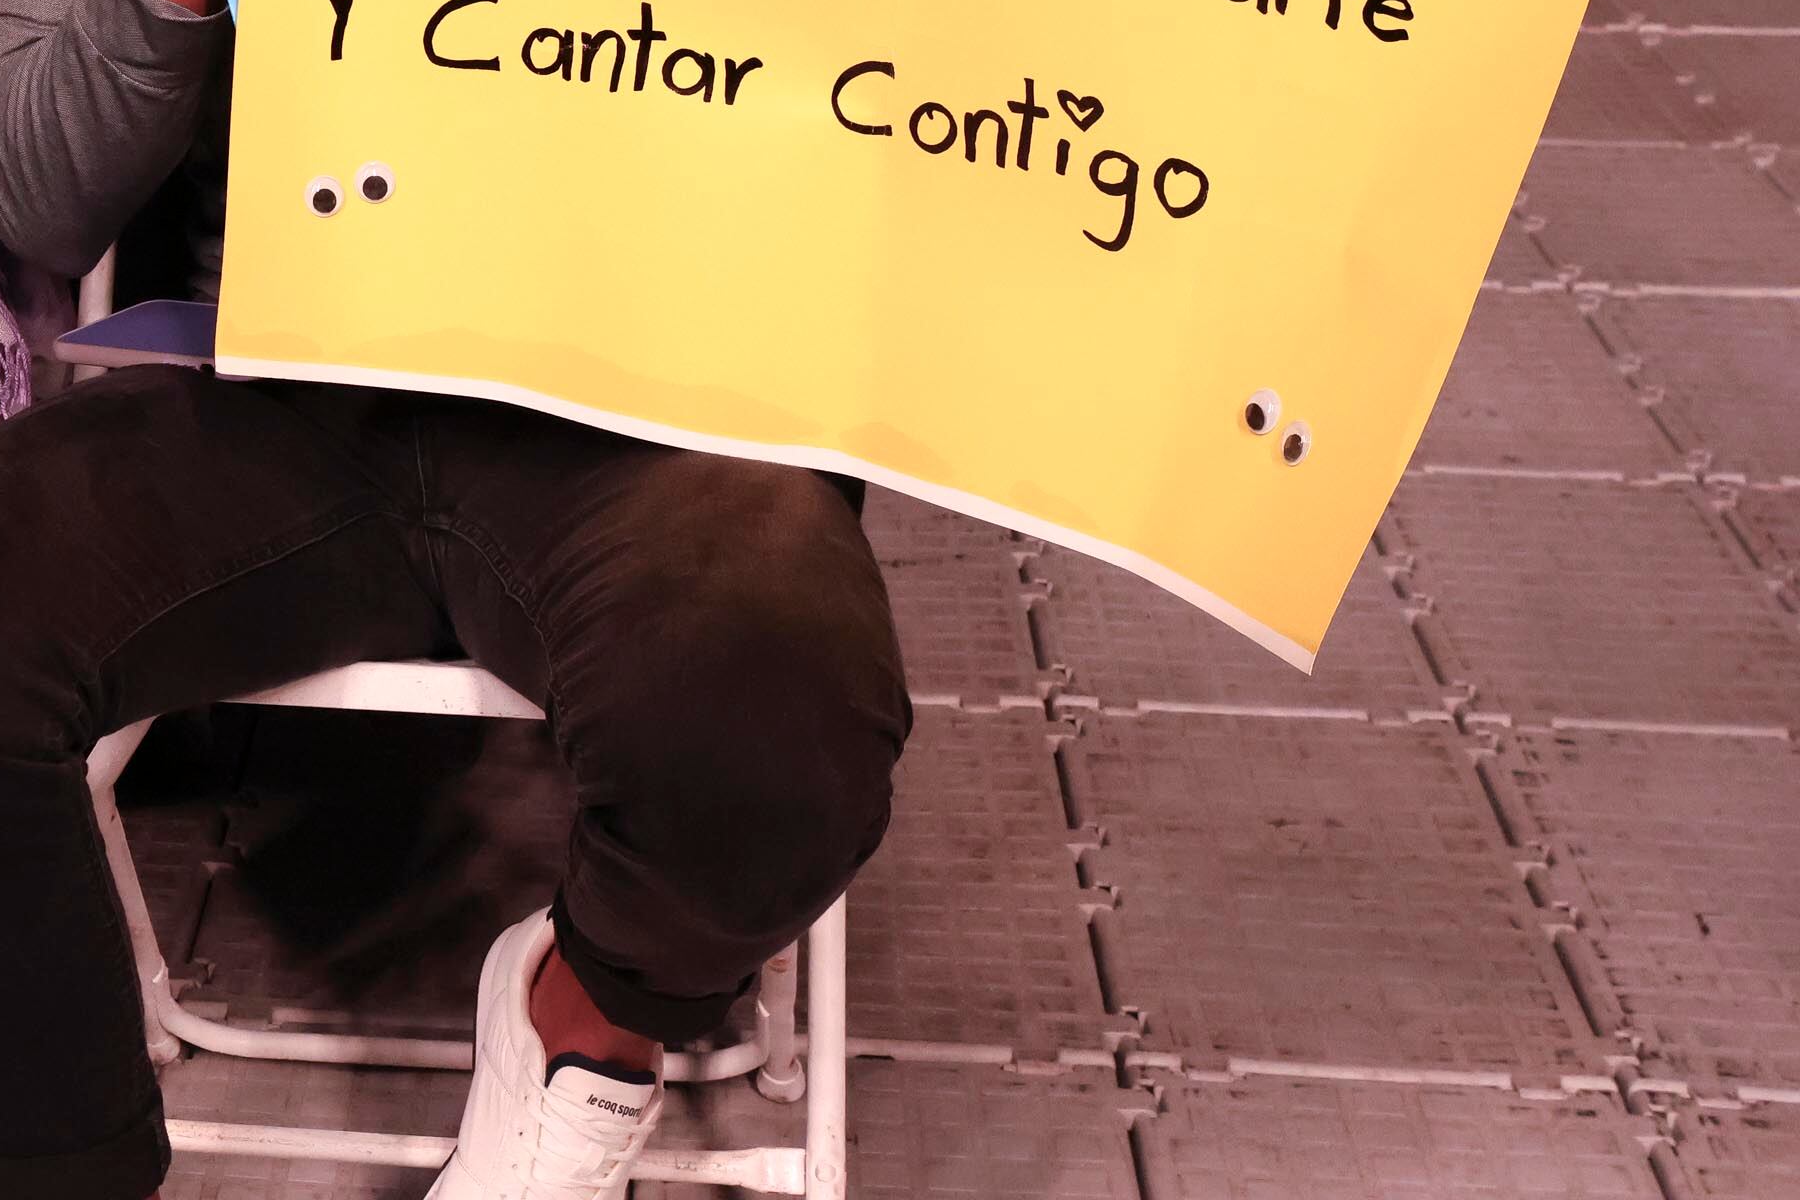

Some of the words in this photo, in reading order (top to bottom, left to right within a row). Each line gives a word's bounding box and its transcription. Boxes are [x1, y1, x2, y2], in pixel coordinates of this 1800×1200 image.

[831, 60, 1209, 252] Contigo
[586, 1093, 599, 1106] le
[597, 1099, 618, 1115] coq
